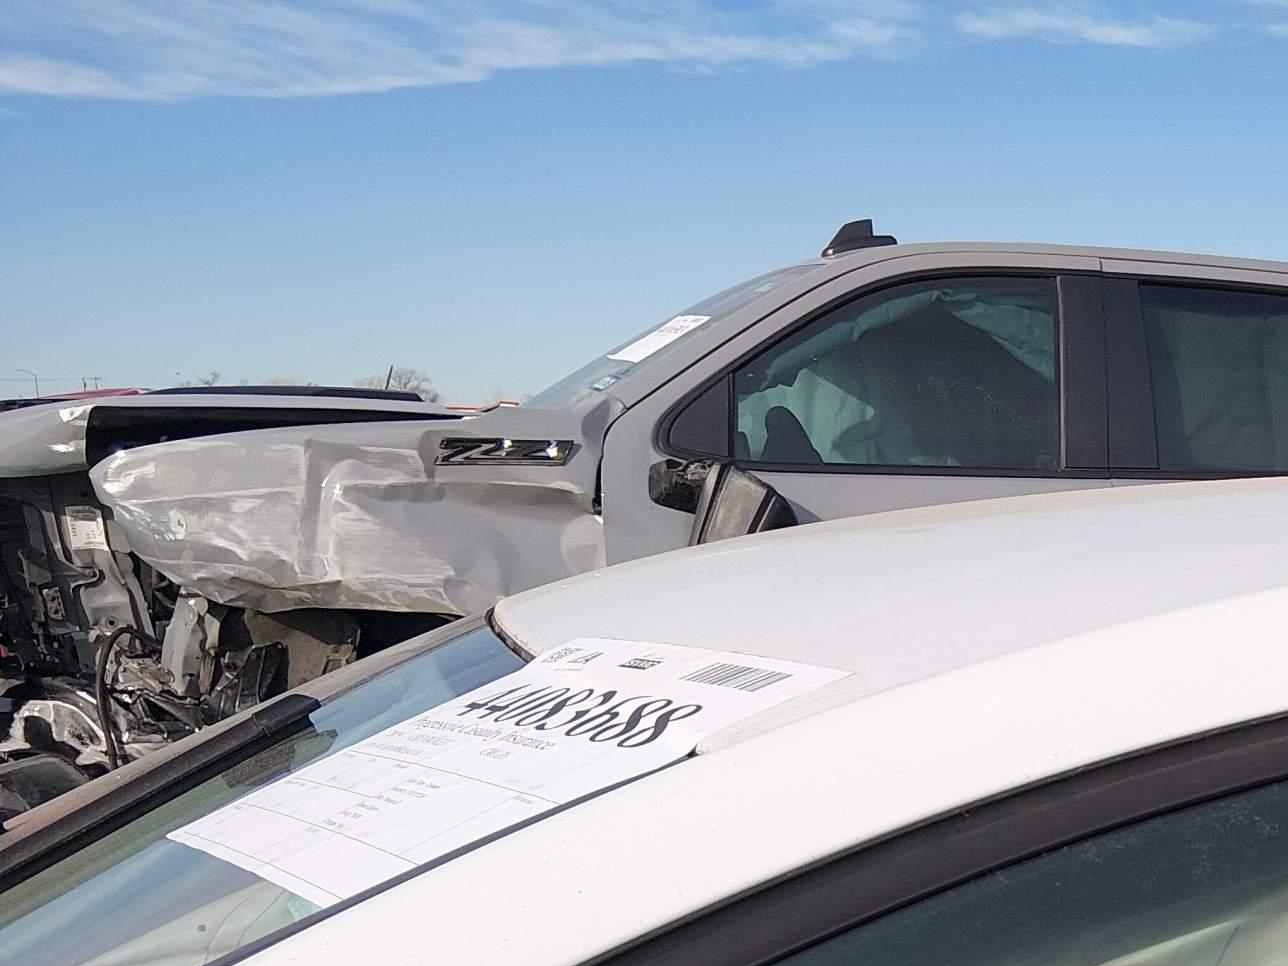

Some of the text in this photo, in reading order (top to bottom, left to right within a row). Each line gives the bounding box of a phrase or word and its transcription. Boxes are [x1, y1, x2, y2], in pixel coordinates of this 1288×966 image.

[411, 715, 556, 751] Progressive Casualty Insurance
[457, 684, 703, 749] 44083688
